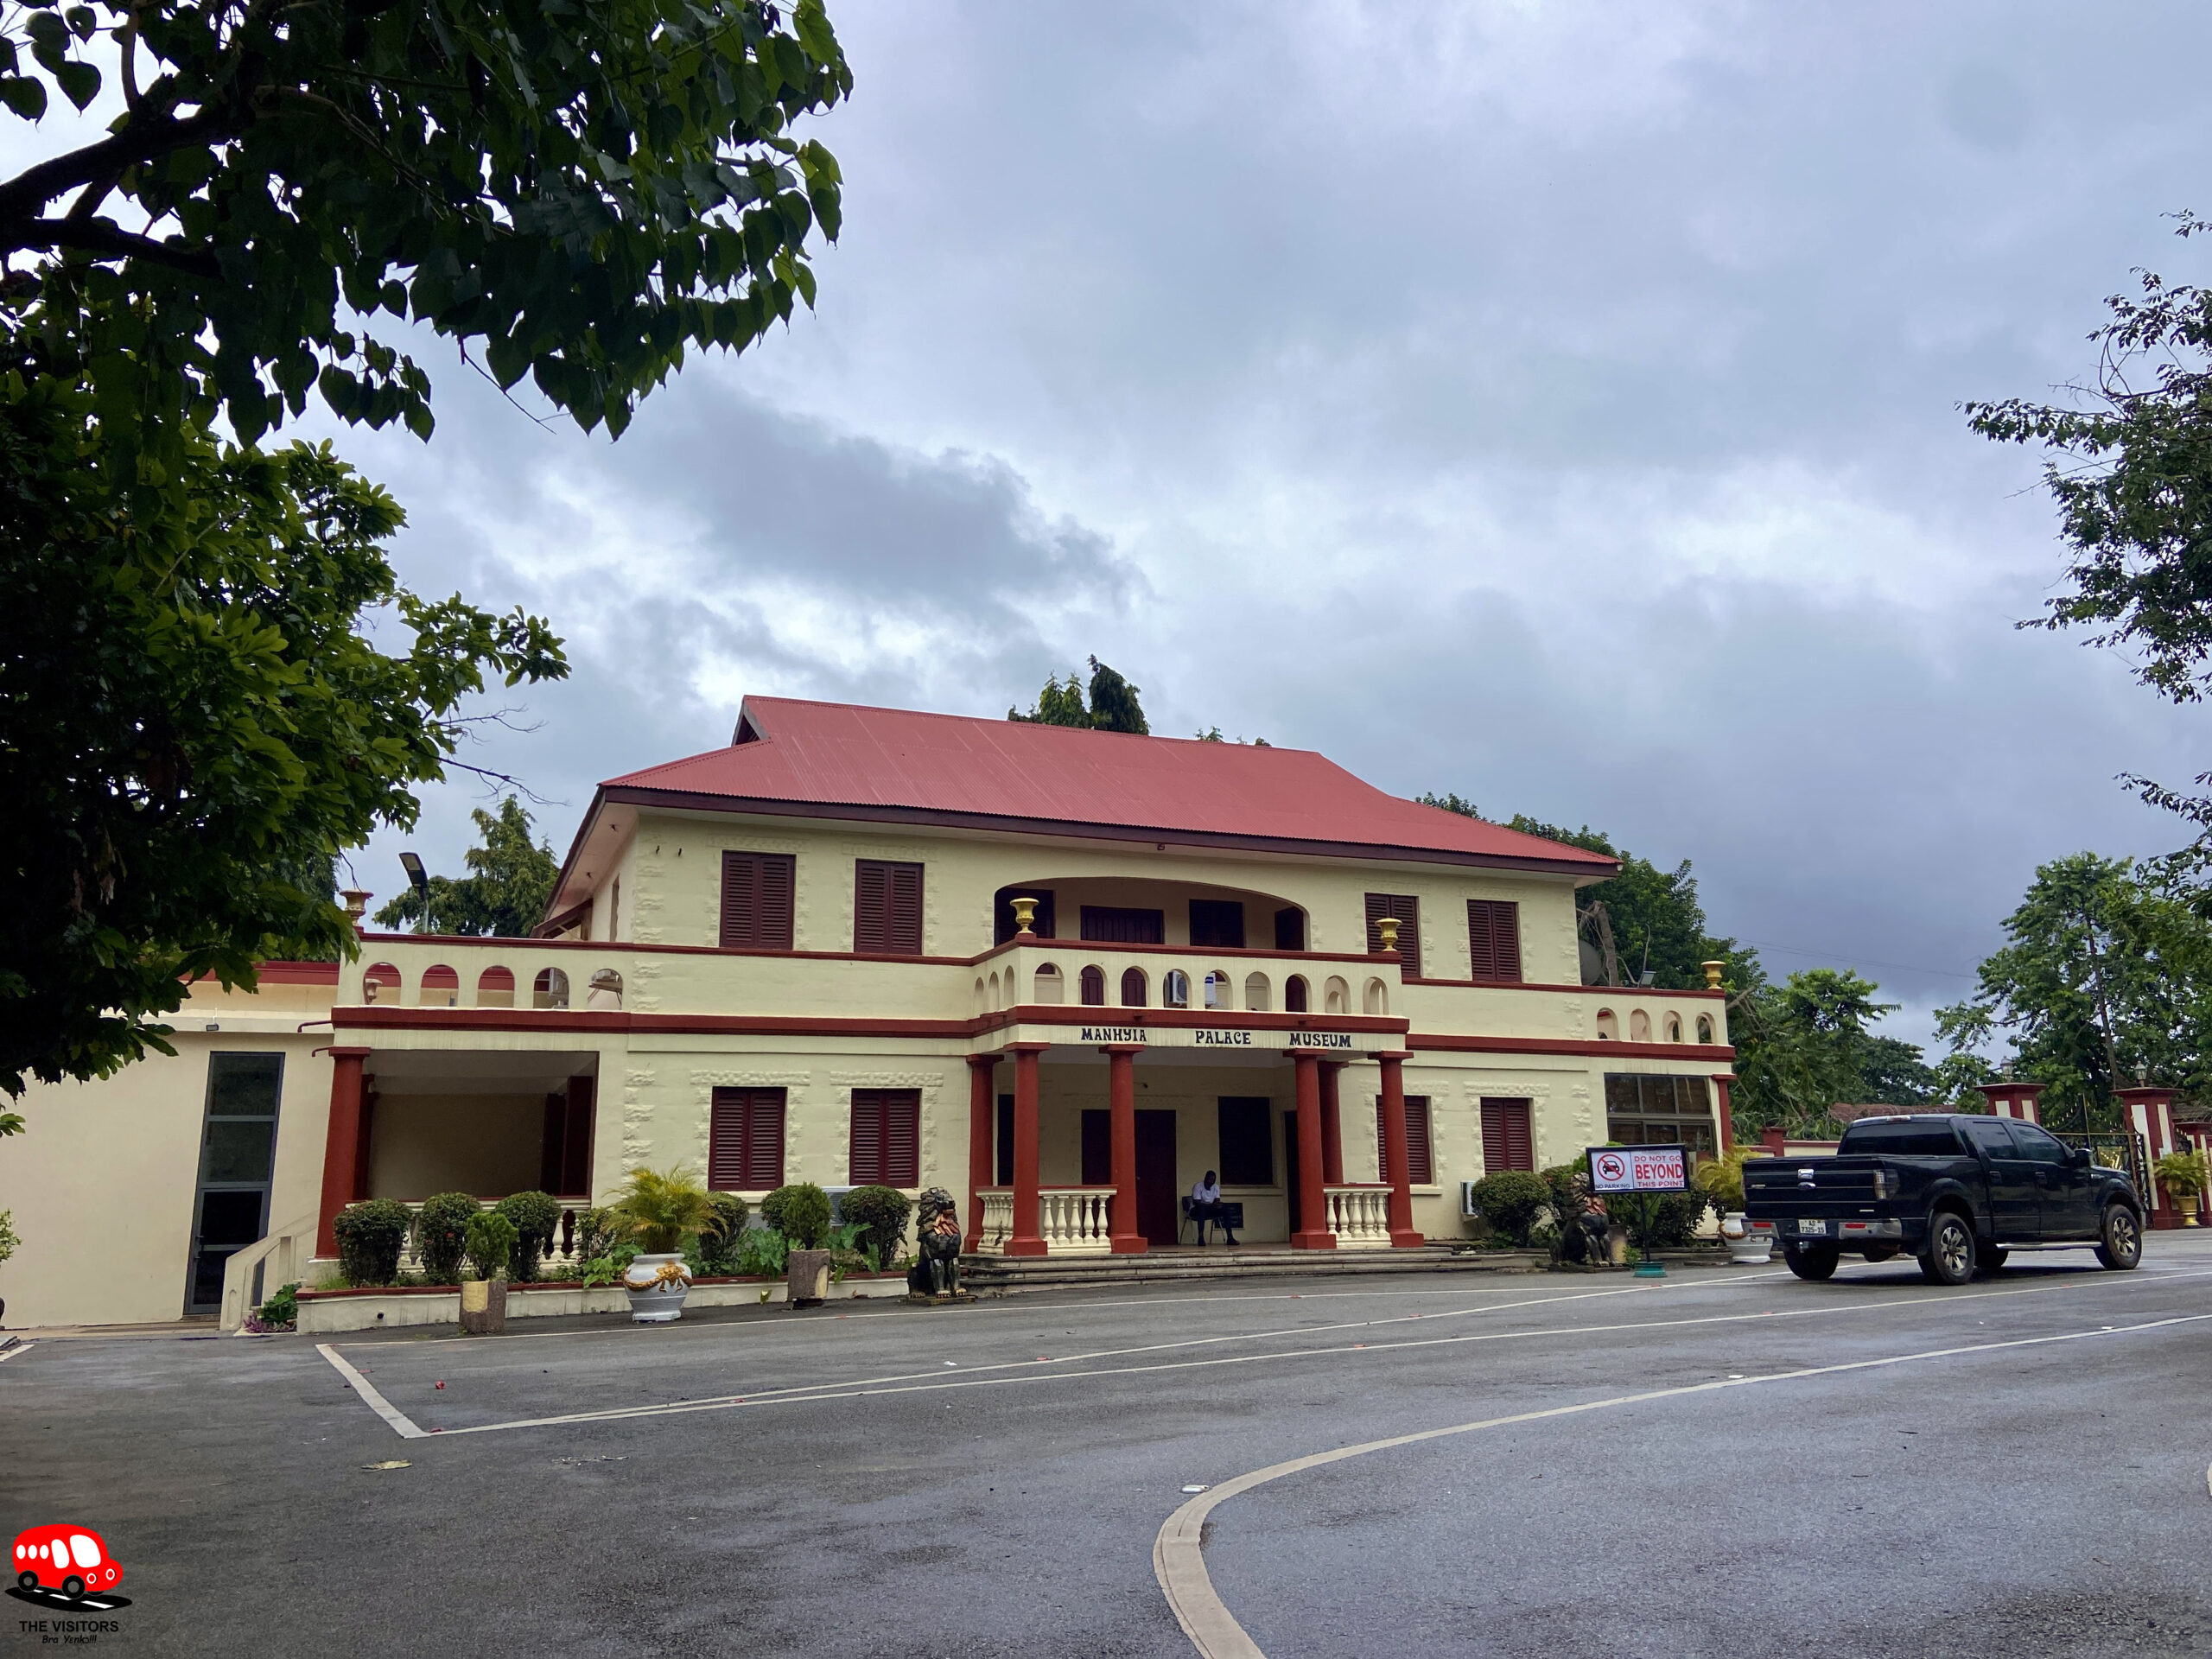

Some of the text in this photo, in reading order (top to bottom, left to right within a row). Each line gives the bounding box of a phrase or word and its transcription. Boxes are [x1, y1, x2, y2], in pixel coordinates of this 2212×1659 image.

[1081, 1028, 1352, 1048] MANHYIA PALACE MUSEUM
[1635, 1164, 1683, 1179] BEYOND
